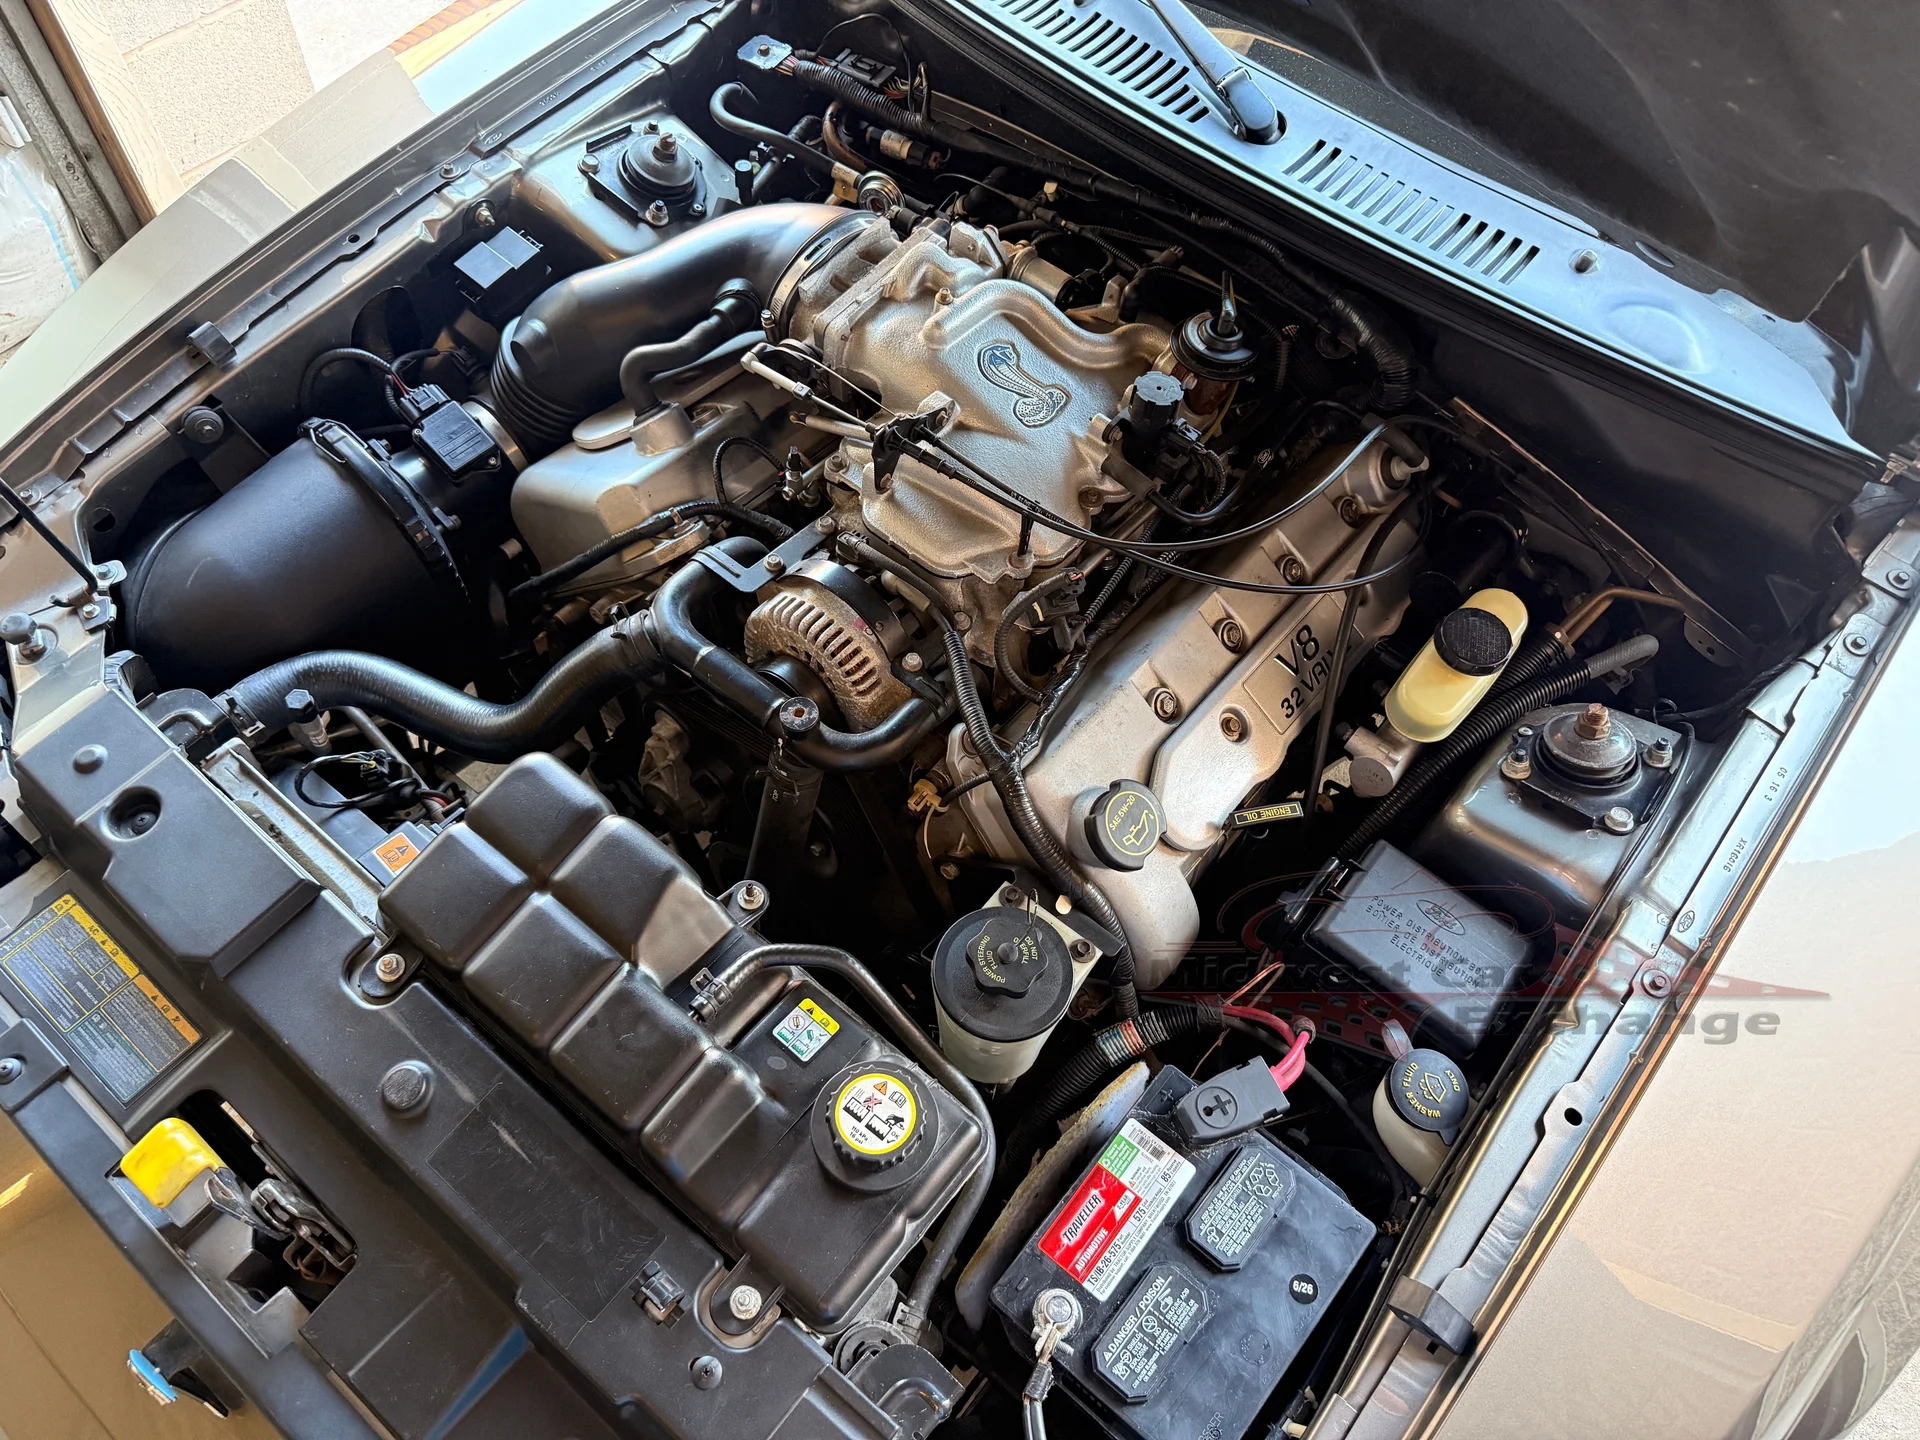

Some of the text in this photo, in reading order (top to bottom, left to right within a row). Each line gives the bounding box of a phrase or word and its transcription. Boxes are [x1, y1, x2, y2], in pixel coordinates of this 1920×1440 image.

[1273, 624, 1320, 677] V8
[1280, 689, 1305, 718] 32
[1776, 766, 1788, 778] 05
[1768, 781, 1779, 792] 16
[1108, 793, 1136, 830] SAE 5W-20
[1243, 806, 1291, 820] ENGINE OIL
[1424, 904, 1456, 929] Ford
[1371, 894, 1487, 978] POWER DISTRIBUTION BOX
[977, 935, 1006, 984] POWER STEERING
[986, 950, 999, 970] FLUID
[1013, 937, 1029, 964] OERFILL
[1025, 936, 1038, 961] DO NOT
[1403, 930, 1417, 943] DE
[1419, 942, 1480, 988] DISTRIBUTION
[1402, 1062, 1441, 1118] WASHER FLUID
[1445, 1069, 1460, 1093] ONLY
[850, 1125, 869, 1141] 110 kPa
[854, 1136, 863, 1145] psi
[890, 1130, 900, 1139] OK
[1159, 1170, 1171, 1182] 85
[1061, 1193, 1103, 1243] TRAVELLER
[1132, 1206, 1146, 1222] 575
[1073, 1226, 1110, 1272] AUTOMOTIVE
[1292, 1280, 1314, 1295] 6/26
[1106, 1313, 1138, 1353] DANGER
[1137, 1275, 1166, 1310] POISON
[1125, 1332, 1141, 1351] SHIELD
[1152, 1326, 1162, 1337] NO
[1128, 1343, 1149, 1369] EXPLOSIVE
[1131, 1341, 1143, 1355] EYES
[1133, 1356, 1148, 1373] GASES
